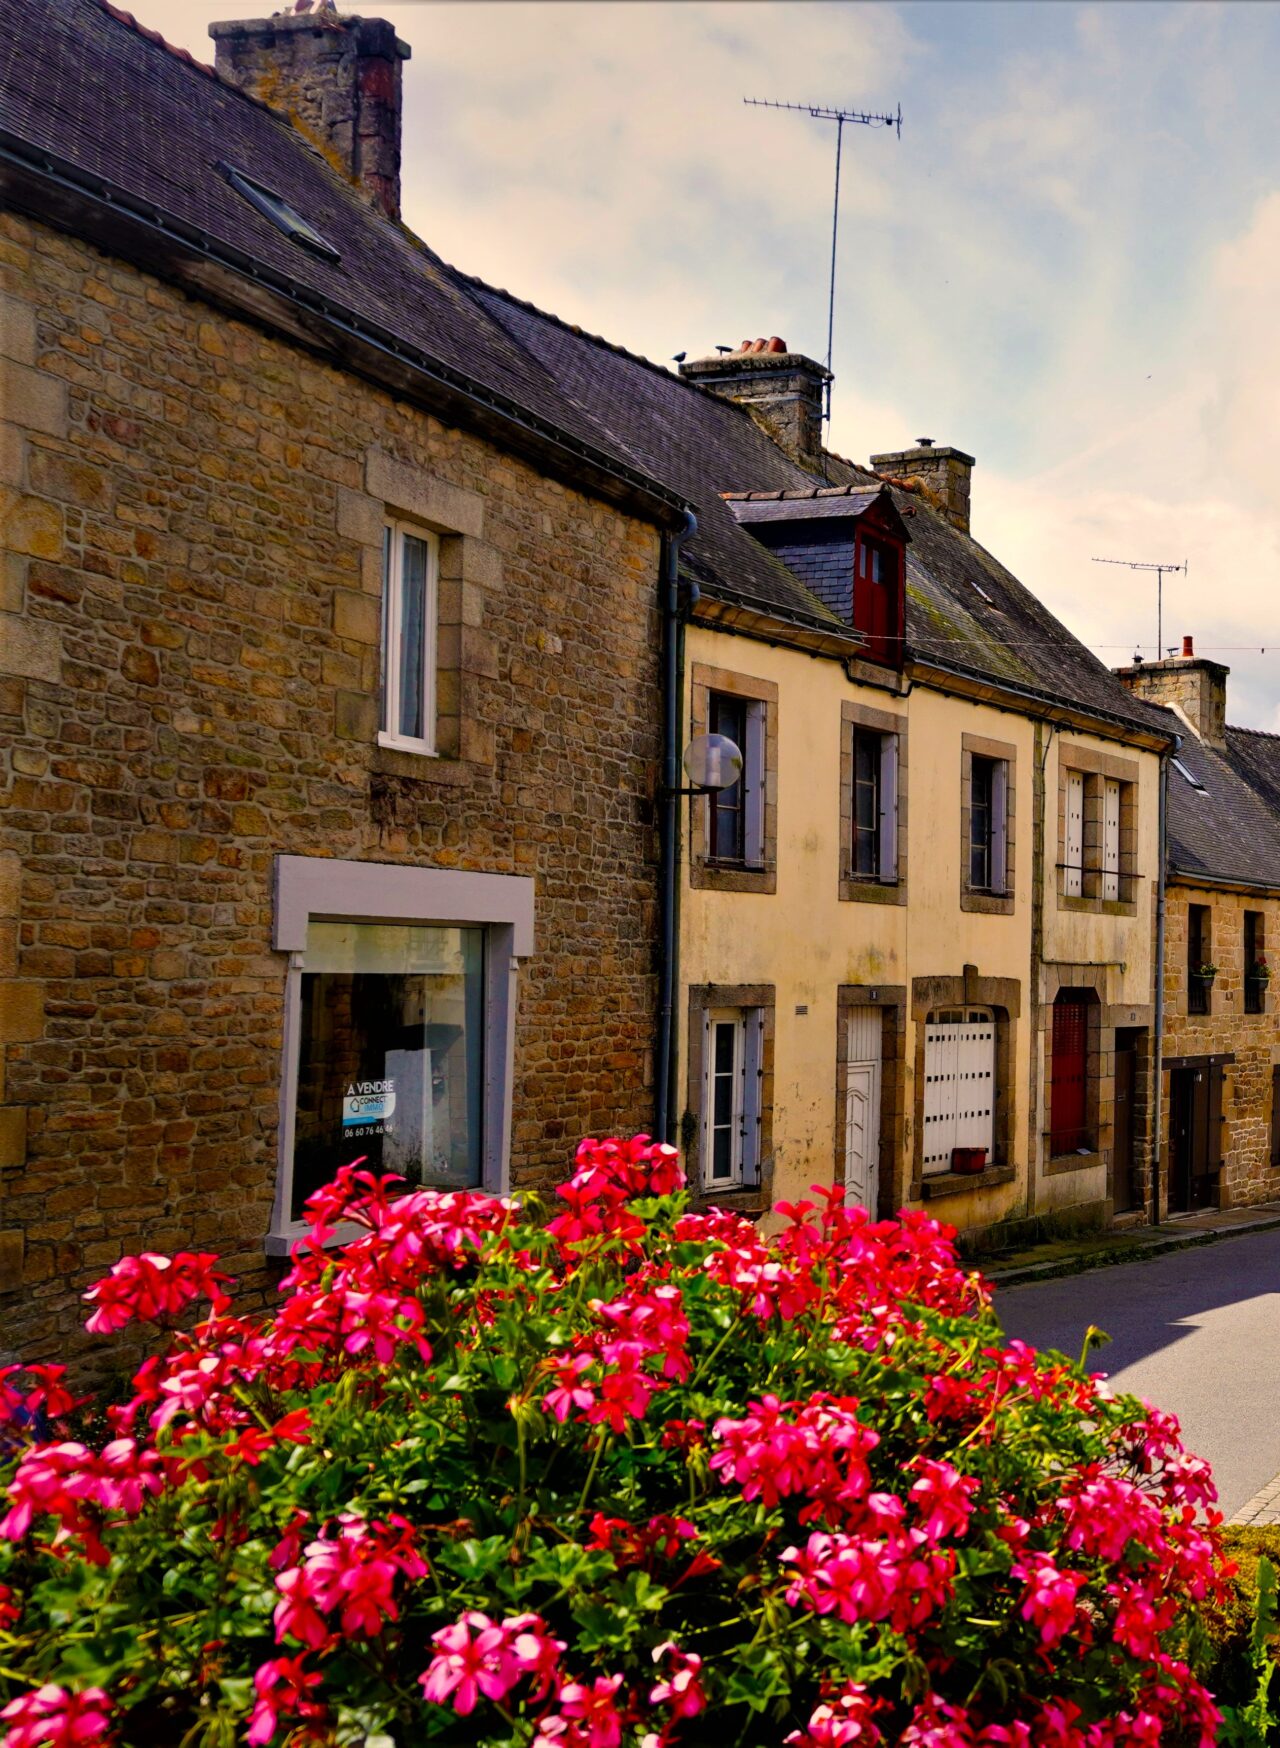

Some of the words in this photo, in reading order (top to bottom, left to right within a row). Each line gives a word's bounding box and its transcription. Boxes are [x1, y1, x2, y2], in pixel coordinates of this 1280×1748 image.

[357, 1080, 393, 1094] VENDRE
[360, 1096, 386, 1104] CONNECT
[345, 1129, 353, 1137] 06
[355, 1128, 364, 1136] 60
[365, 1127, 374, 1135] 76
